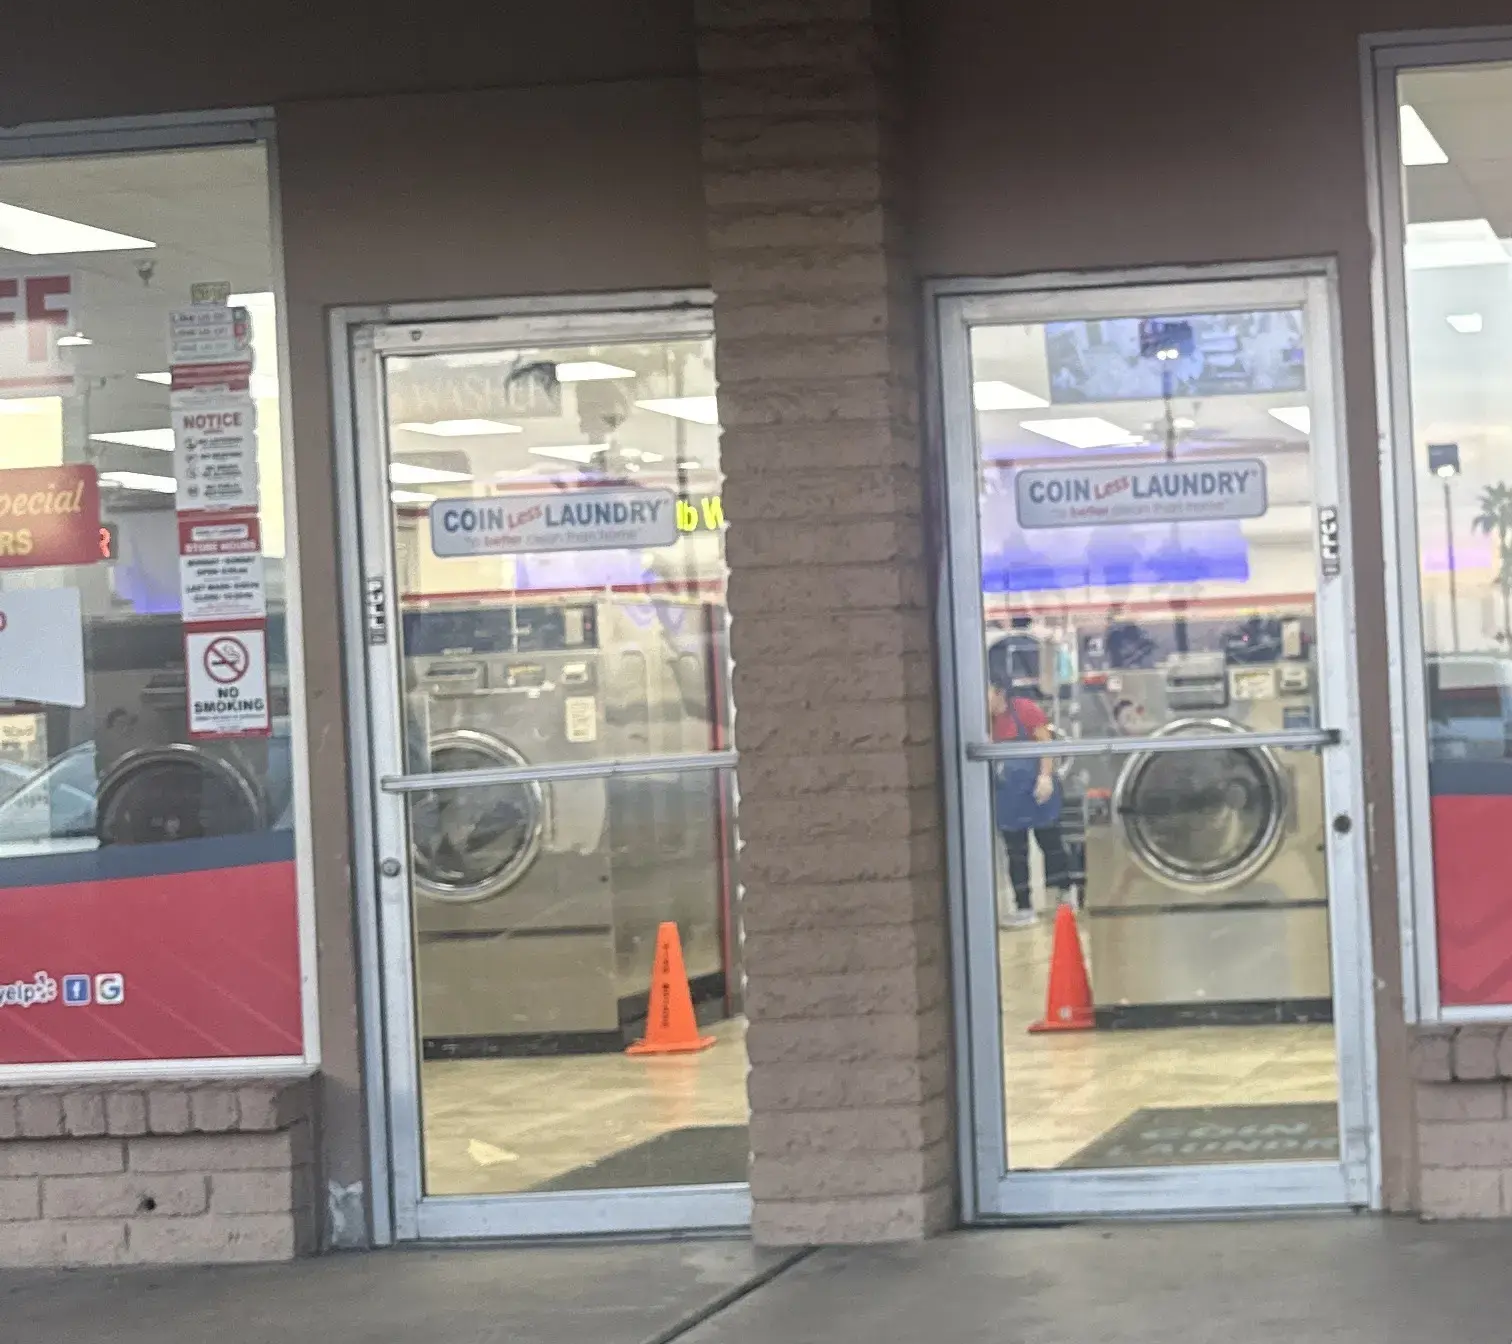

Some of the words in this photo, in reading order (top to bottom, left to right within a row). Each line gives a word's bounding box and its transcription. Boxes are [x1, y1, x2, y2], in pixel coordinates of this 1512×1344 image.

[183, 412, 242, 430] NOTICE
[1029, 477, 1089, 505] COIN
[1132, 469, 1250, 499] LAUNDRY
[444, 507, 504, 533] COIN
[544, 499, 660, 528] LAUNDRY
[218, 686, 240, 699] NO
[194, 698, 264, 714] SMOKING
